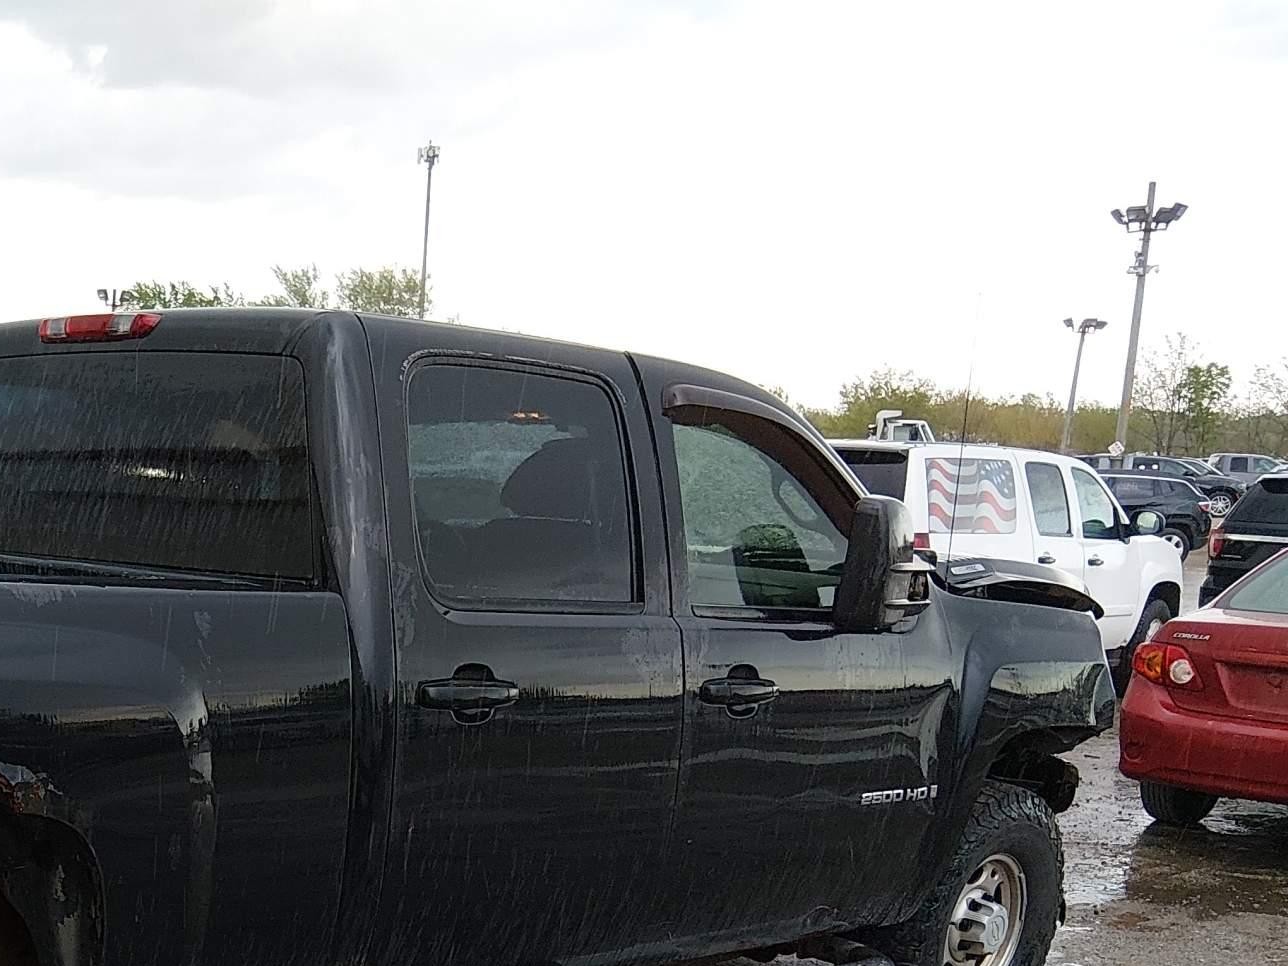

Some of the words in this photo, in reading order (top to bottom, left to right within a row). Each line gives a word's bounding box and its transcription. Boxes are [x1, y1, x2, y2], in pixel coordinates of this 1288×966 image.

[1172, 632, 1211, 641] COROLLA
[860, 789, 904, 806] 2500
[905, 786, 928, 801] HD
